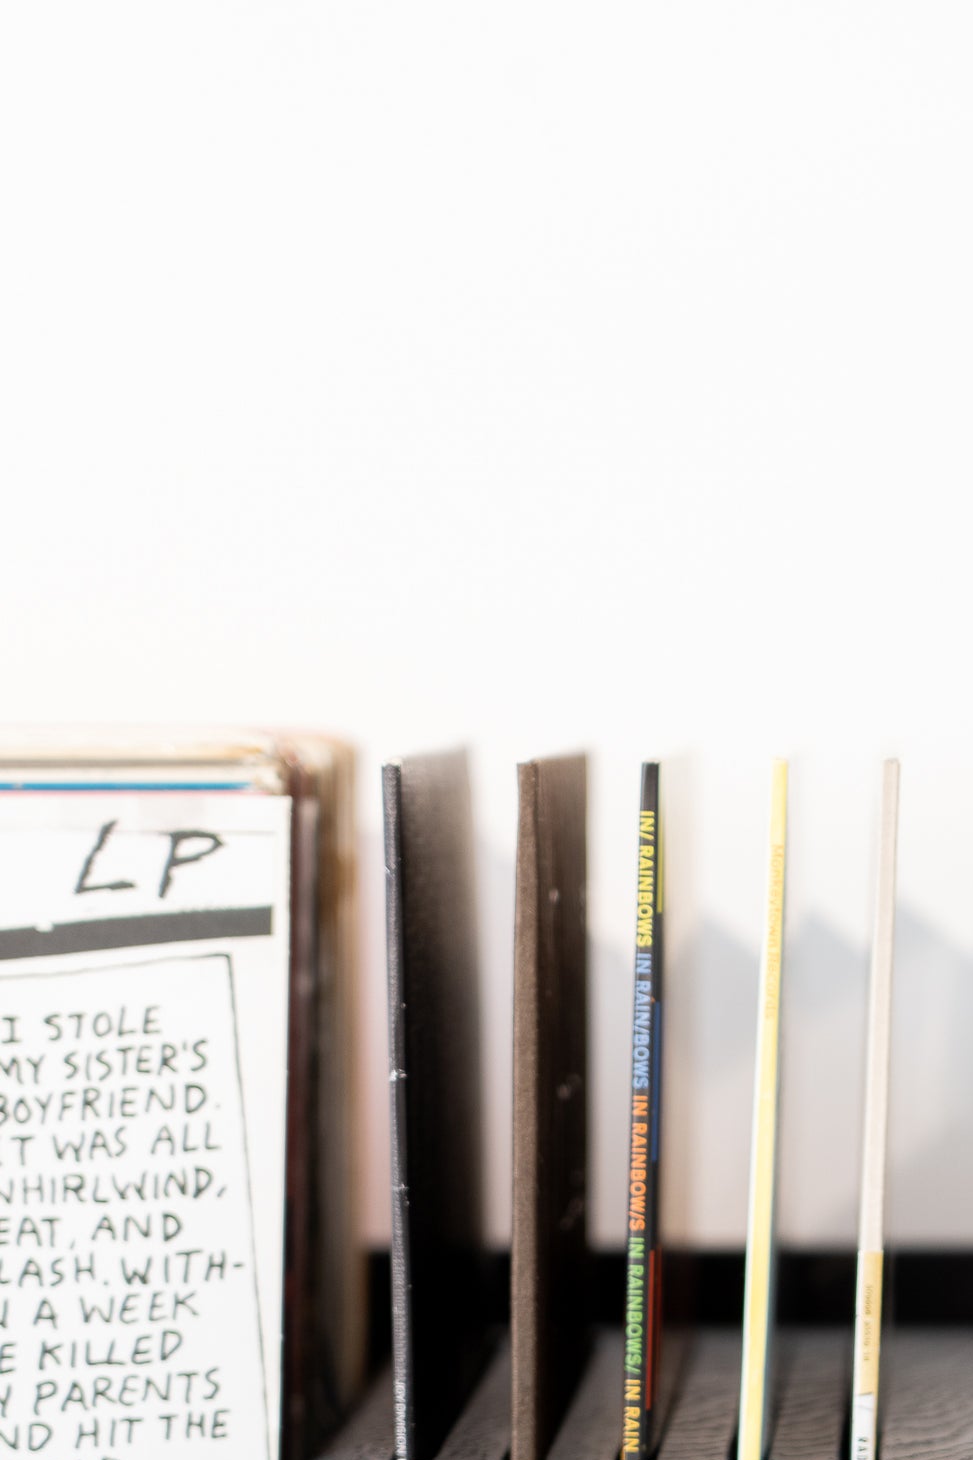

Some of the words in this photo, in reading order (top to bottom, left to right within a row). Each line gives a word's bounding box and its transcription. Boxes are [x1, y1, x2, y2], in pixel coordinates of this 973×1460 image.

[638, 810, 656, 840] IN/
[74, 819, 224, 899] LP
[636, 845, 655, 947] RAINBOWS
[767, 844, 785, 948] Monkeytown
[635, 953, 652, 974] IN
[2, 1016, 21, 1044] I
[44, 1006, 162, 1041] STOLE
[631, 980, 652, 1089] RAIN/BOWS
[63, 1038, 208, 1083] SISTER'S
[631, 1095, 648, 1116] IN
[52, 1125, 128, 1162] WAS
[151, 1122, 221, 1155] ALL
[628, 1122, 648, 1231] RAINBOW/S
[91, 1213, 182, 1242] AND
[121, 1250, 244, 1285] WITH-
[627, 1237, 645, 1259] IN
[33, 1298, 58, 1329] A
[79, 1291, 200, 1324] WEEK
[624, 1264, 644, 1375] RAINBOWS/
[38, 1330, 183, 1370] KILLED
[33, 1367, 220, 1414] PARENTS
[624, 1379, 641, 1401] IN
[74, 1417, 144, 1449] HIT
[158, 1409, 231, 1440] THE
